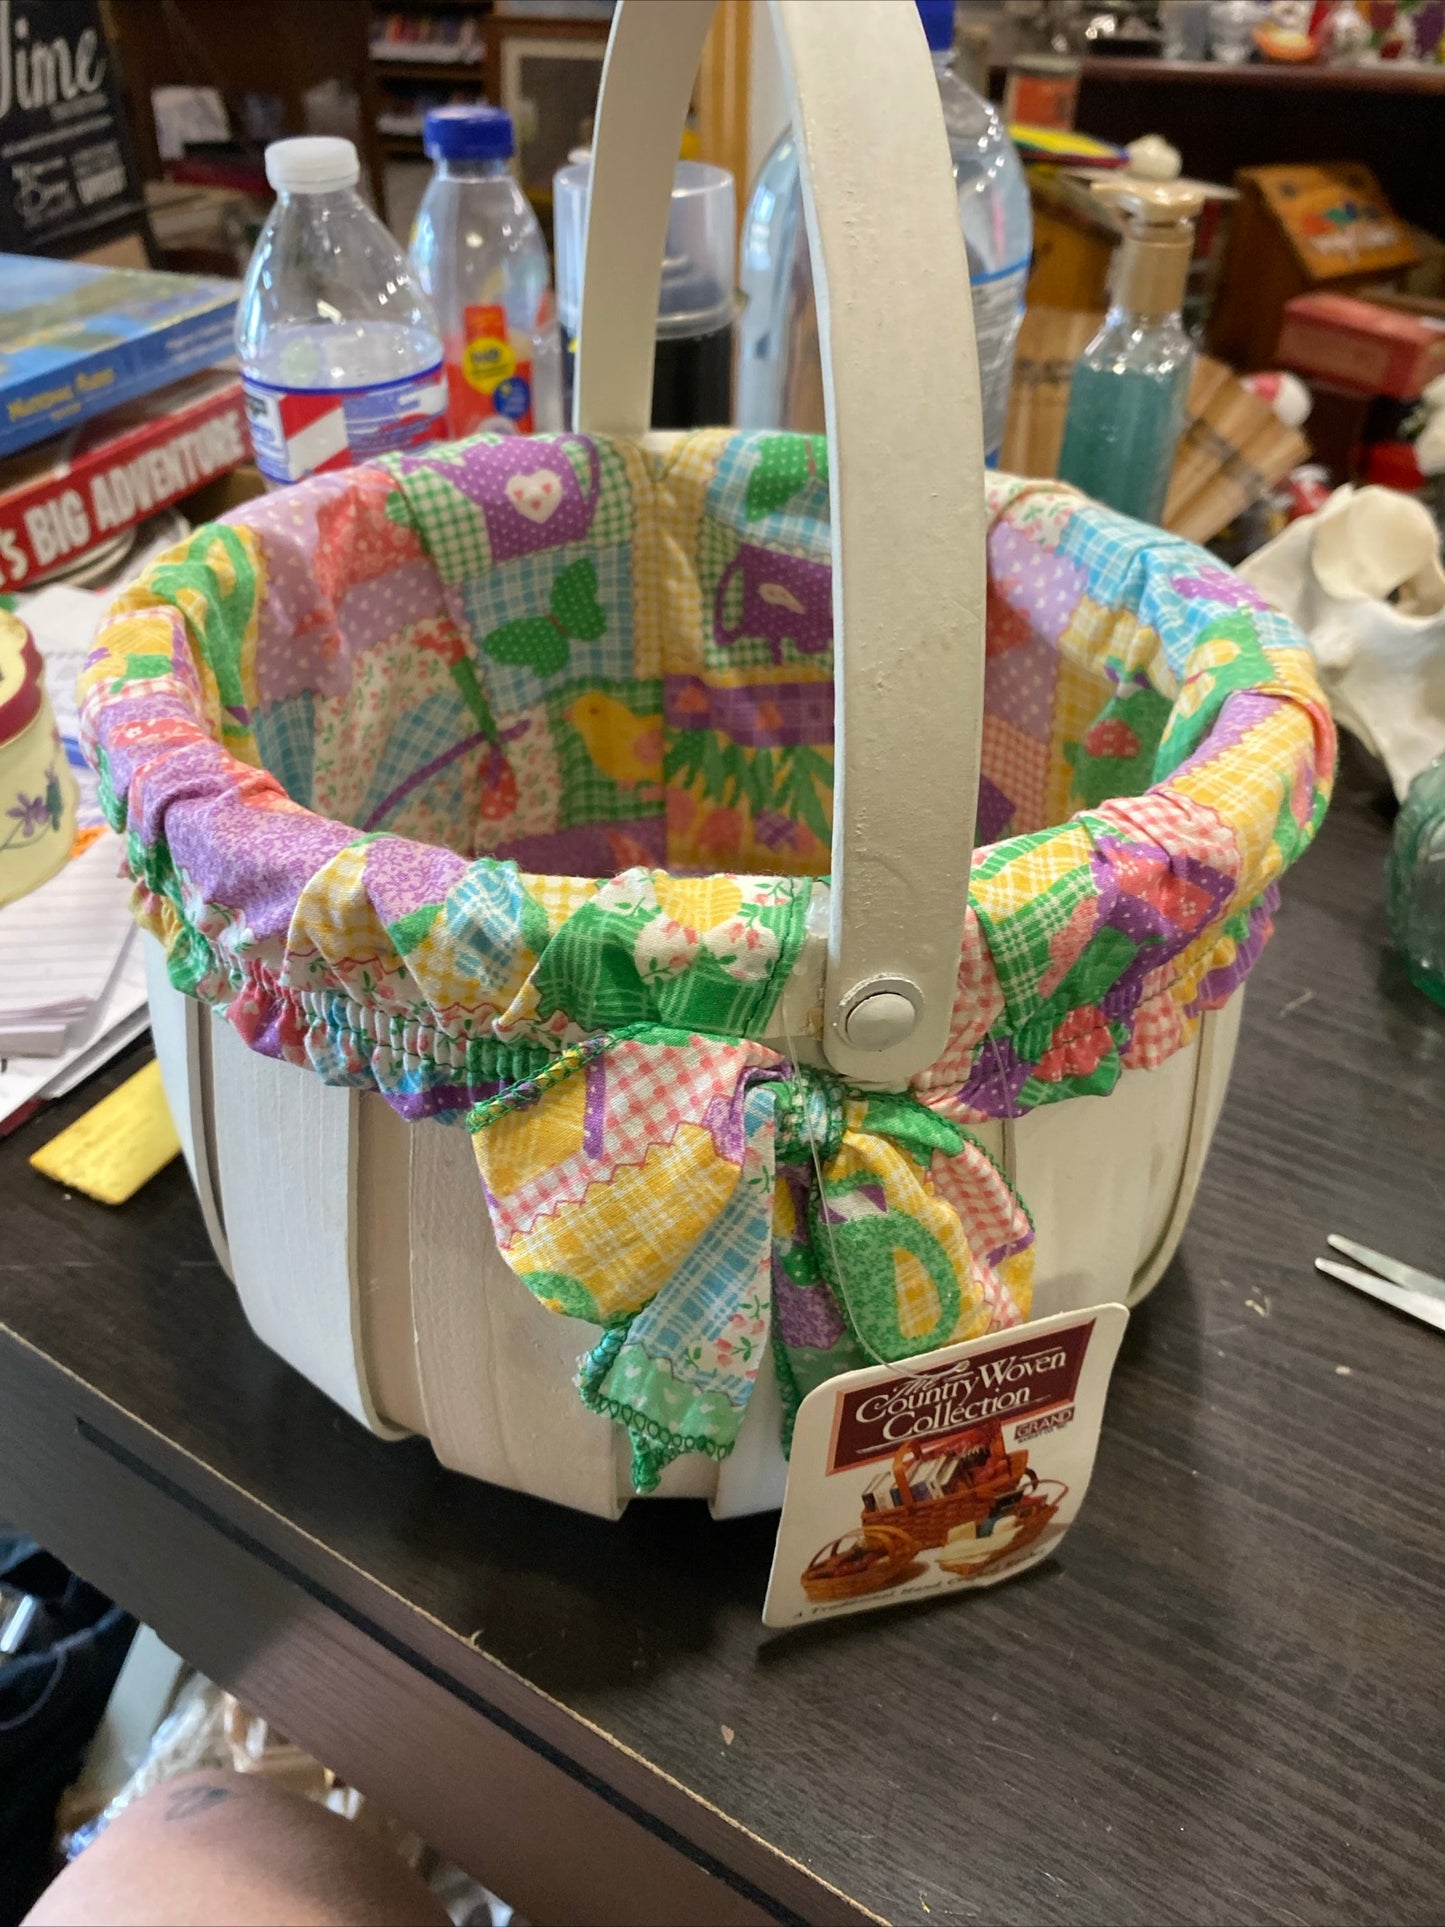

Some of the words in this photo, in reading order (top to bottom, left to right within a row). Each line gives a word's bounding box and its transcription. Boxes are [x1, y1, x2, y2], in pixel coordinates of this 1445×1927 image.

[24, 490, 92, 566] BIG
[89, 410, 244, 531] ADVENTURE
[855, 1374, 979, 1424] Country
[978, 1351, 1066, 1389] Woven
[882, 1386, 1031, 1442] Collection
[1016, 1408, 1073, 1437] GRAND
